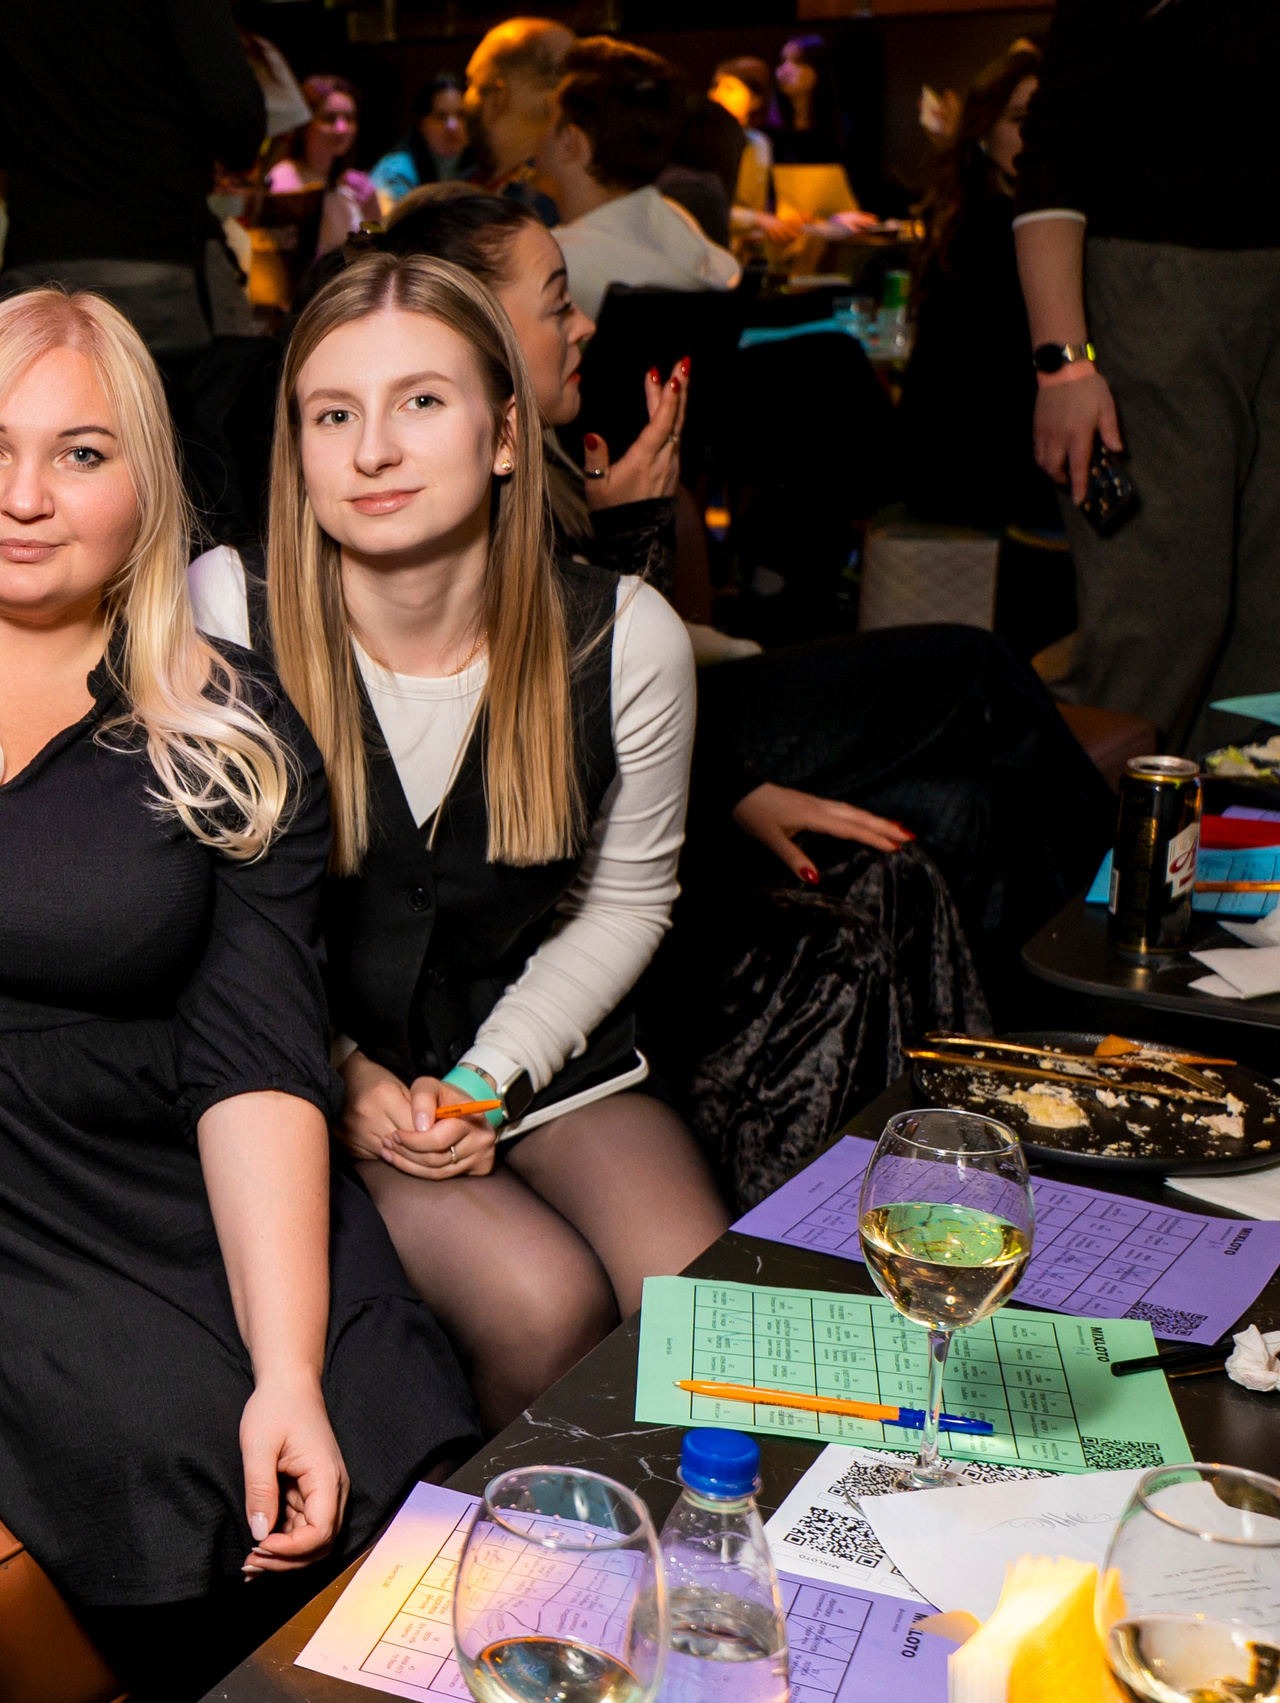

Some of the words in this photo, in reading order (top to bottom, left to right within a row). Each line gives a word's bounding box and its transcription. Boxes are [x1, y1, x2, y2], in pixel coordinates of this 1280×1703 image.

[1224, 1228, 1253, 1255] MIXLOTO
[1090, 1326, 1110, 1362] MIXLOTO
[799, 1554, 840, 1569] MIXLOTO
[901, 1612, 929, 1658] MLOTO
